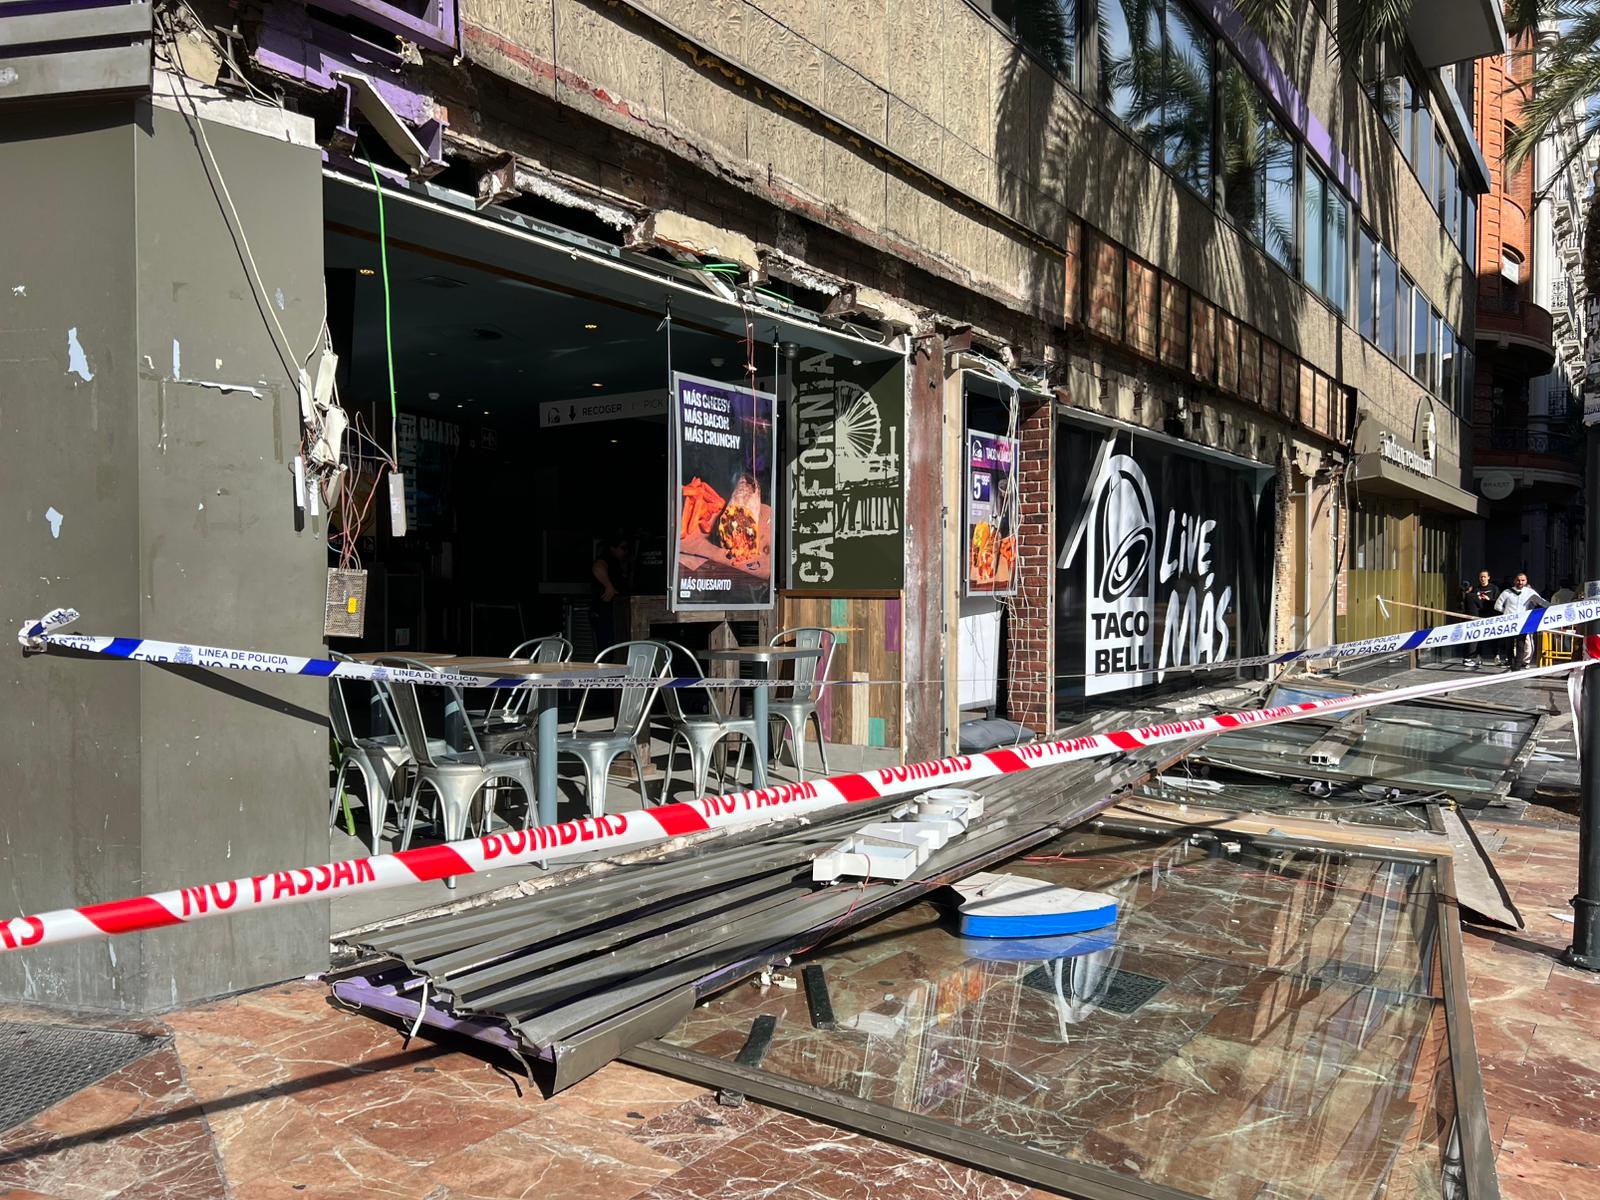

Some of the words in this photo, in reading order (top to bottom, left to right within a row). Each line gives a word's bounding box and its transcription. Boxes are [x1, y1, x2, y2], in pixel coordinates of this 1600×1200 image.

[582, 403, 623, 417] RECOGER
[682, 389, 702, 408] MÁS
[684, 407, 703, 425] MÁS
[703, 411, 730, 431] BACON
[684, 425, 704, 444] MÁS
[704, 430, 741, 450] CRUNCHY
[799, 352, 834, 583] CALIFORNIA
[973, 475, 981, 499] 5
[680, 577, 697, 591] MÁS
[696, 578, 732, 592] QUESARITO
[1091, 612, 1149, 641] TACO
[1157, 572, 1232, 684] MÁS
[1543, 614, 1562, 625] CNP
[1578, 608, 1593, 620] NO
[1425, 635, 1448, 645] CNP
[1464, 629, 1481, 641] NO
[1483, 622, 1518, 638] PASAR
[198, 647, 229, 660] LINEA
[231, 651, 245, 661] DE
[247, 653, 288, 666] POLICIA
[1095, 645, 1150, 674] BELL
[1337, 648, 1356, 657] NO
[1357, 642, 1397, 655] PASAR
[393, 669, 422, 679] LINEA
[424, 671, 437, 680] DE
[440, 674, 480, 683] POLICIA
[479, 812, 629, 861] BOMBERS
[702, 793, 737, 818] NO
[181, 879, 238, 918] NO
[251, 857, 376, 903] PASSAR
